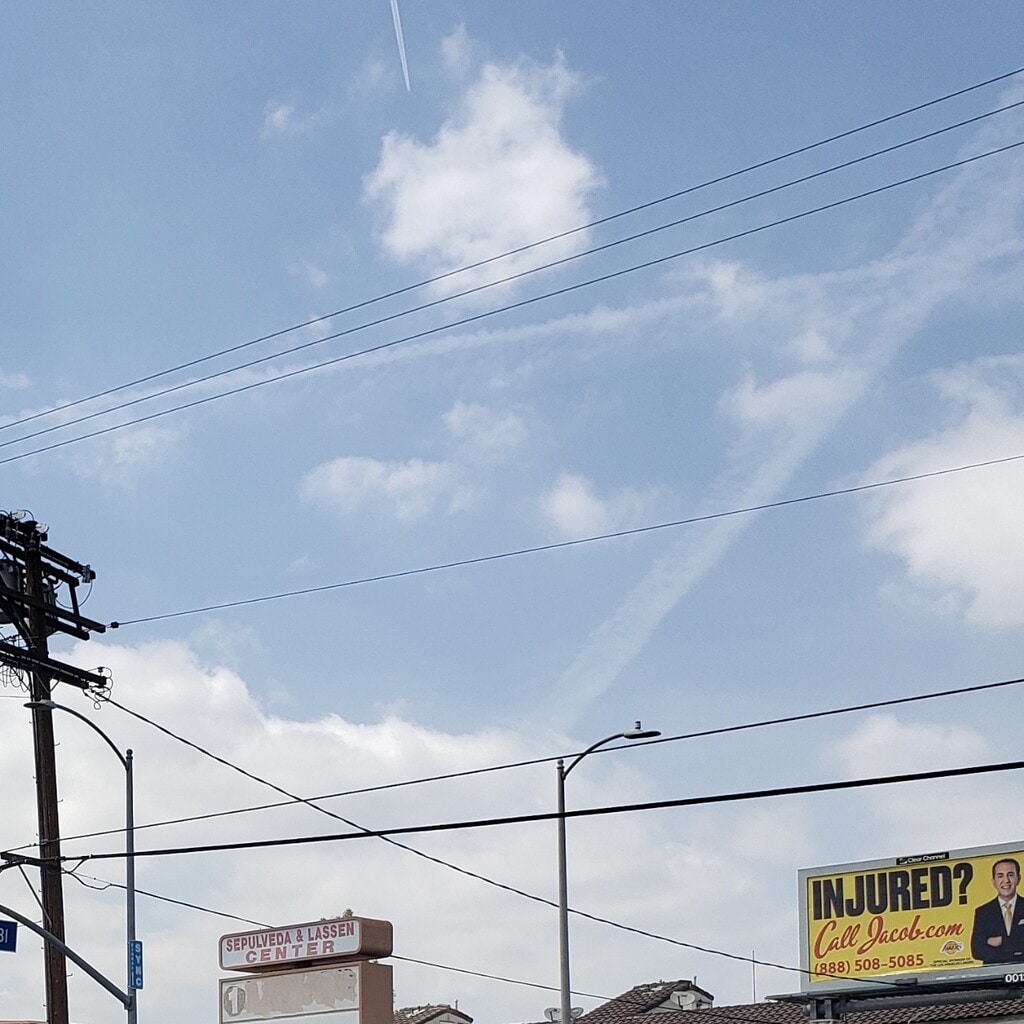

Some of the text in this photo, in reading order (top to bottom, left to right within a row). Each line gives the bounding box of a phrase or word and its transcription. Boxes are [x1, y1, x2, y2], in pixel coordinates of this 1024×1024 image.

[812, 862, 974, 920] INJURED?
[226, 922, 355, 952] SEPULVEDA & LASSEN
[814, 914, 964, 960] Call Jacob.com
[246, 940, 336, 964] CENTER
[814, 960, 851, 977] (888)
[1005, 974, 1024, 983] 001
